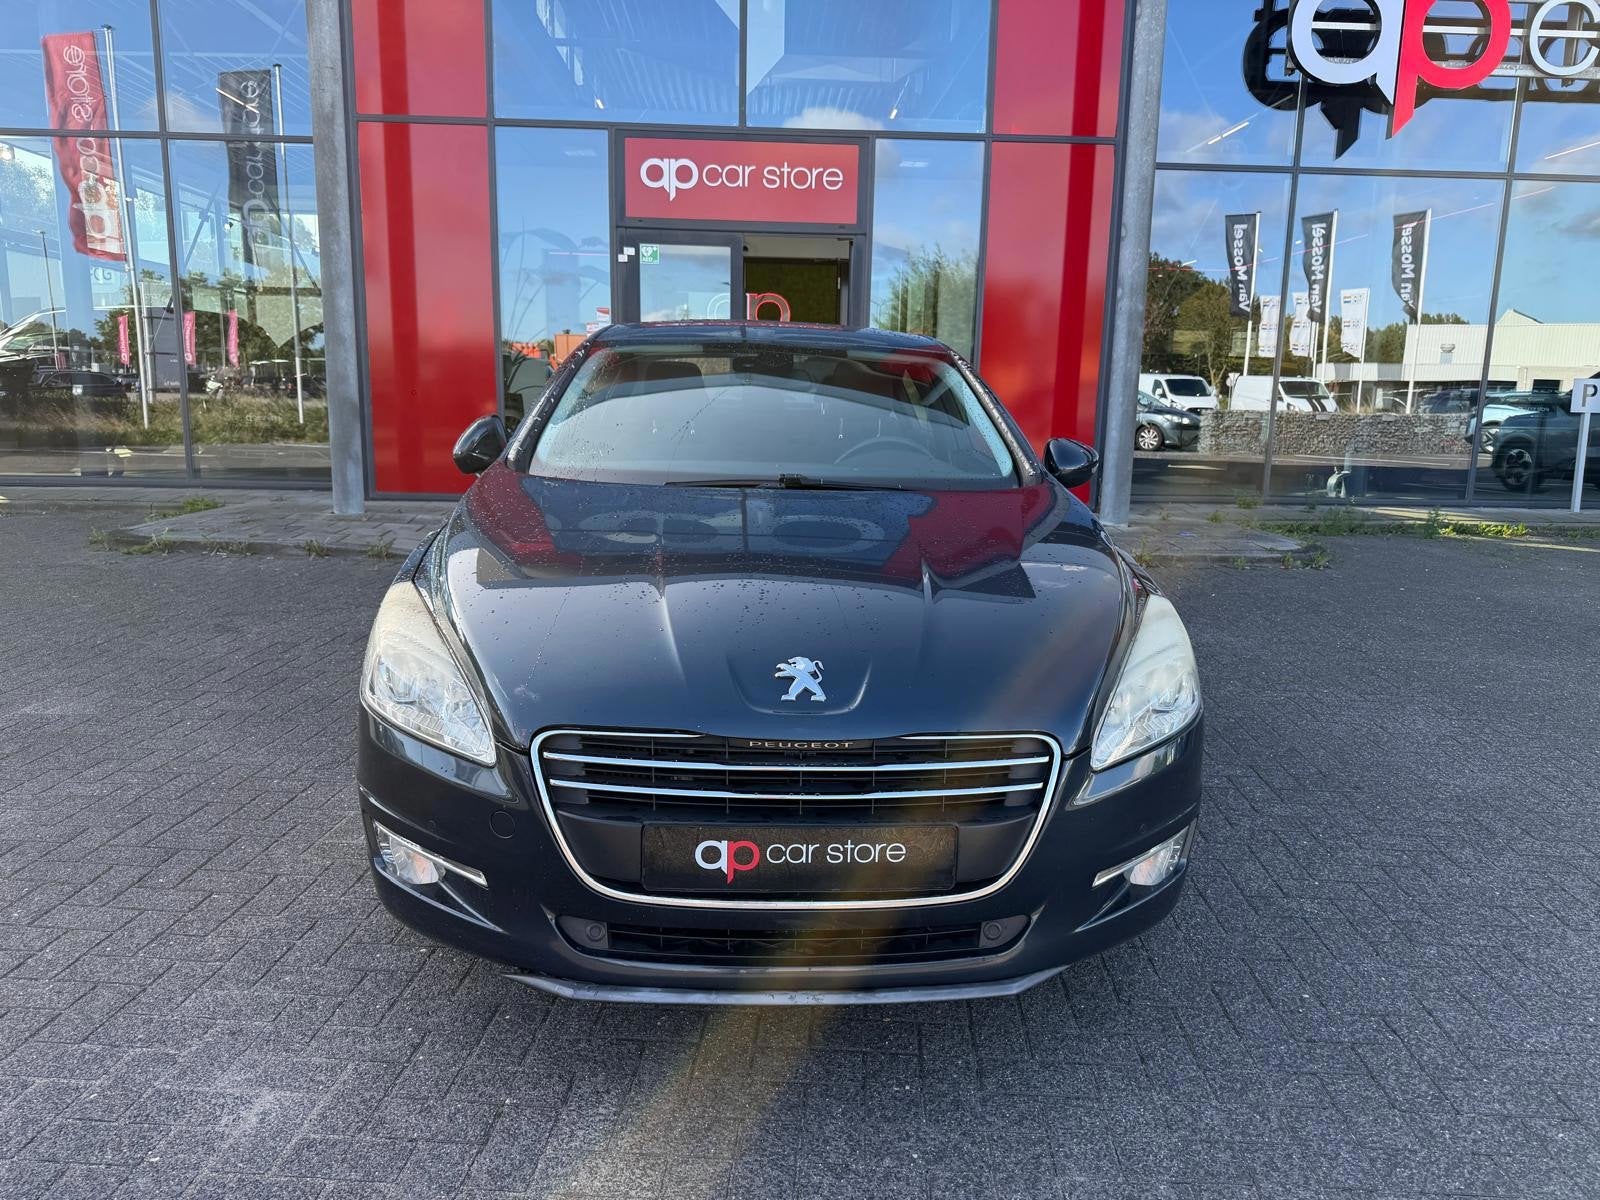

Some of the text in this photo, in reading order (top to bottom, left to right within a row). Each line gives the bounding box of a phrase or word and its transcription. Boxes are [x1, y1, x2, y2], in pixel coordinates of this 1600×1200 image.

[1292, 0, 1511, 137] ap
[640, 157, 844, 201] ap car store
[1581, 384, 1598, 407] P
[749, 741, 854, 749] PEUGEOT
[695, 839, 907, 885] ap car store
